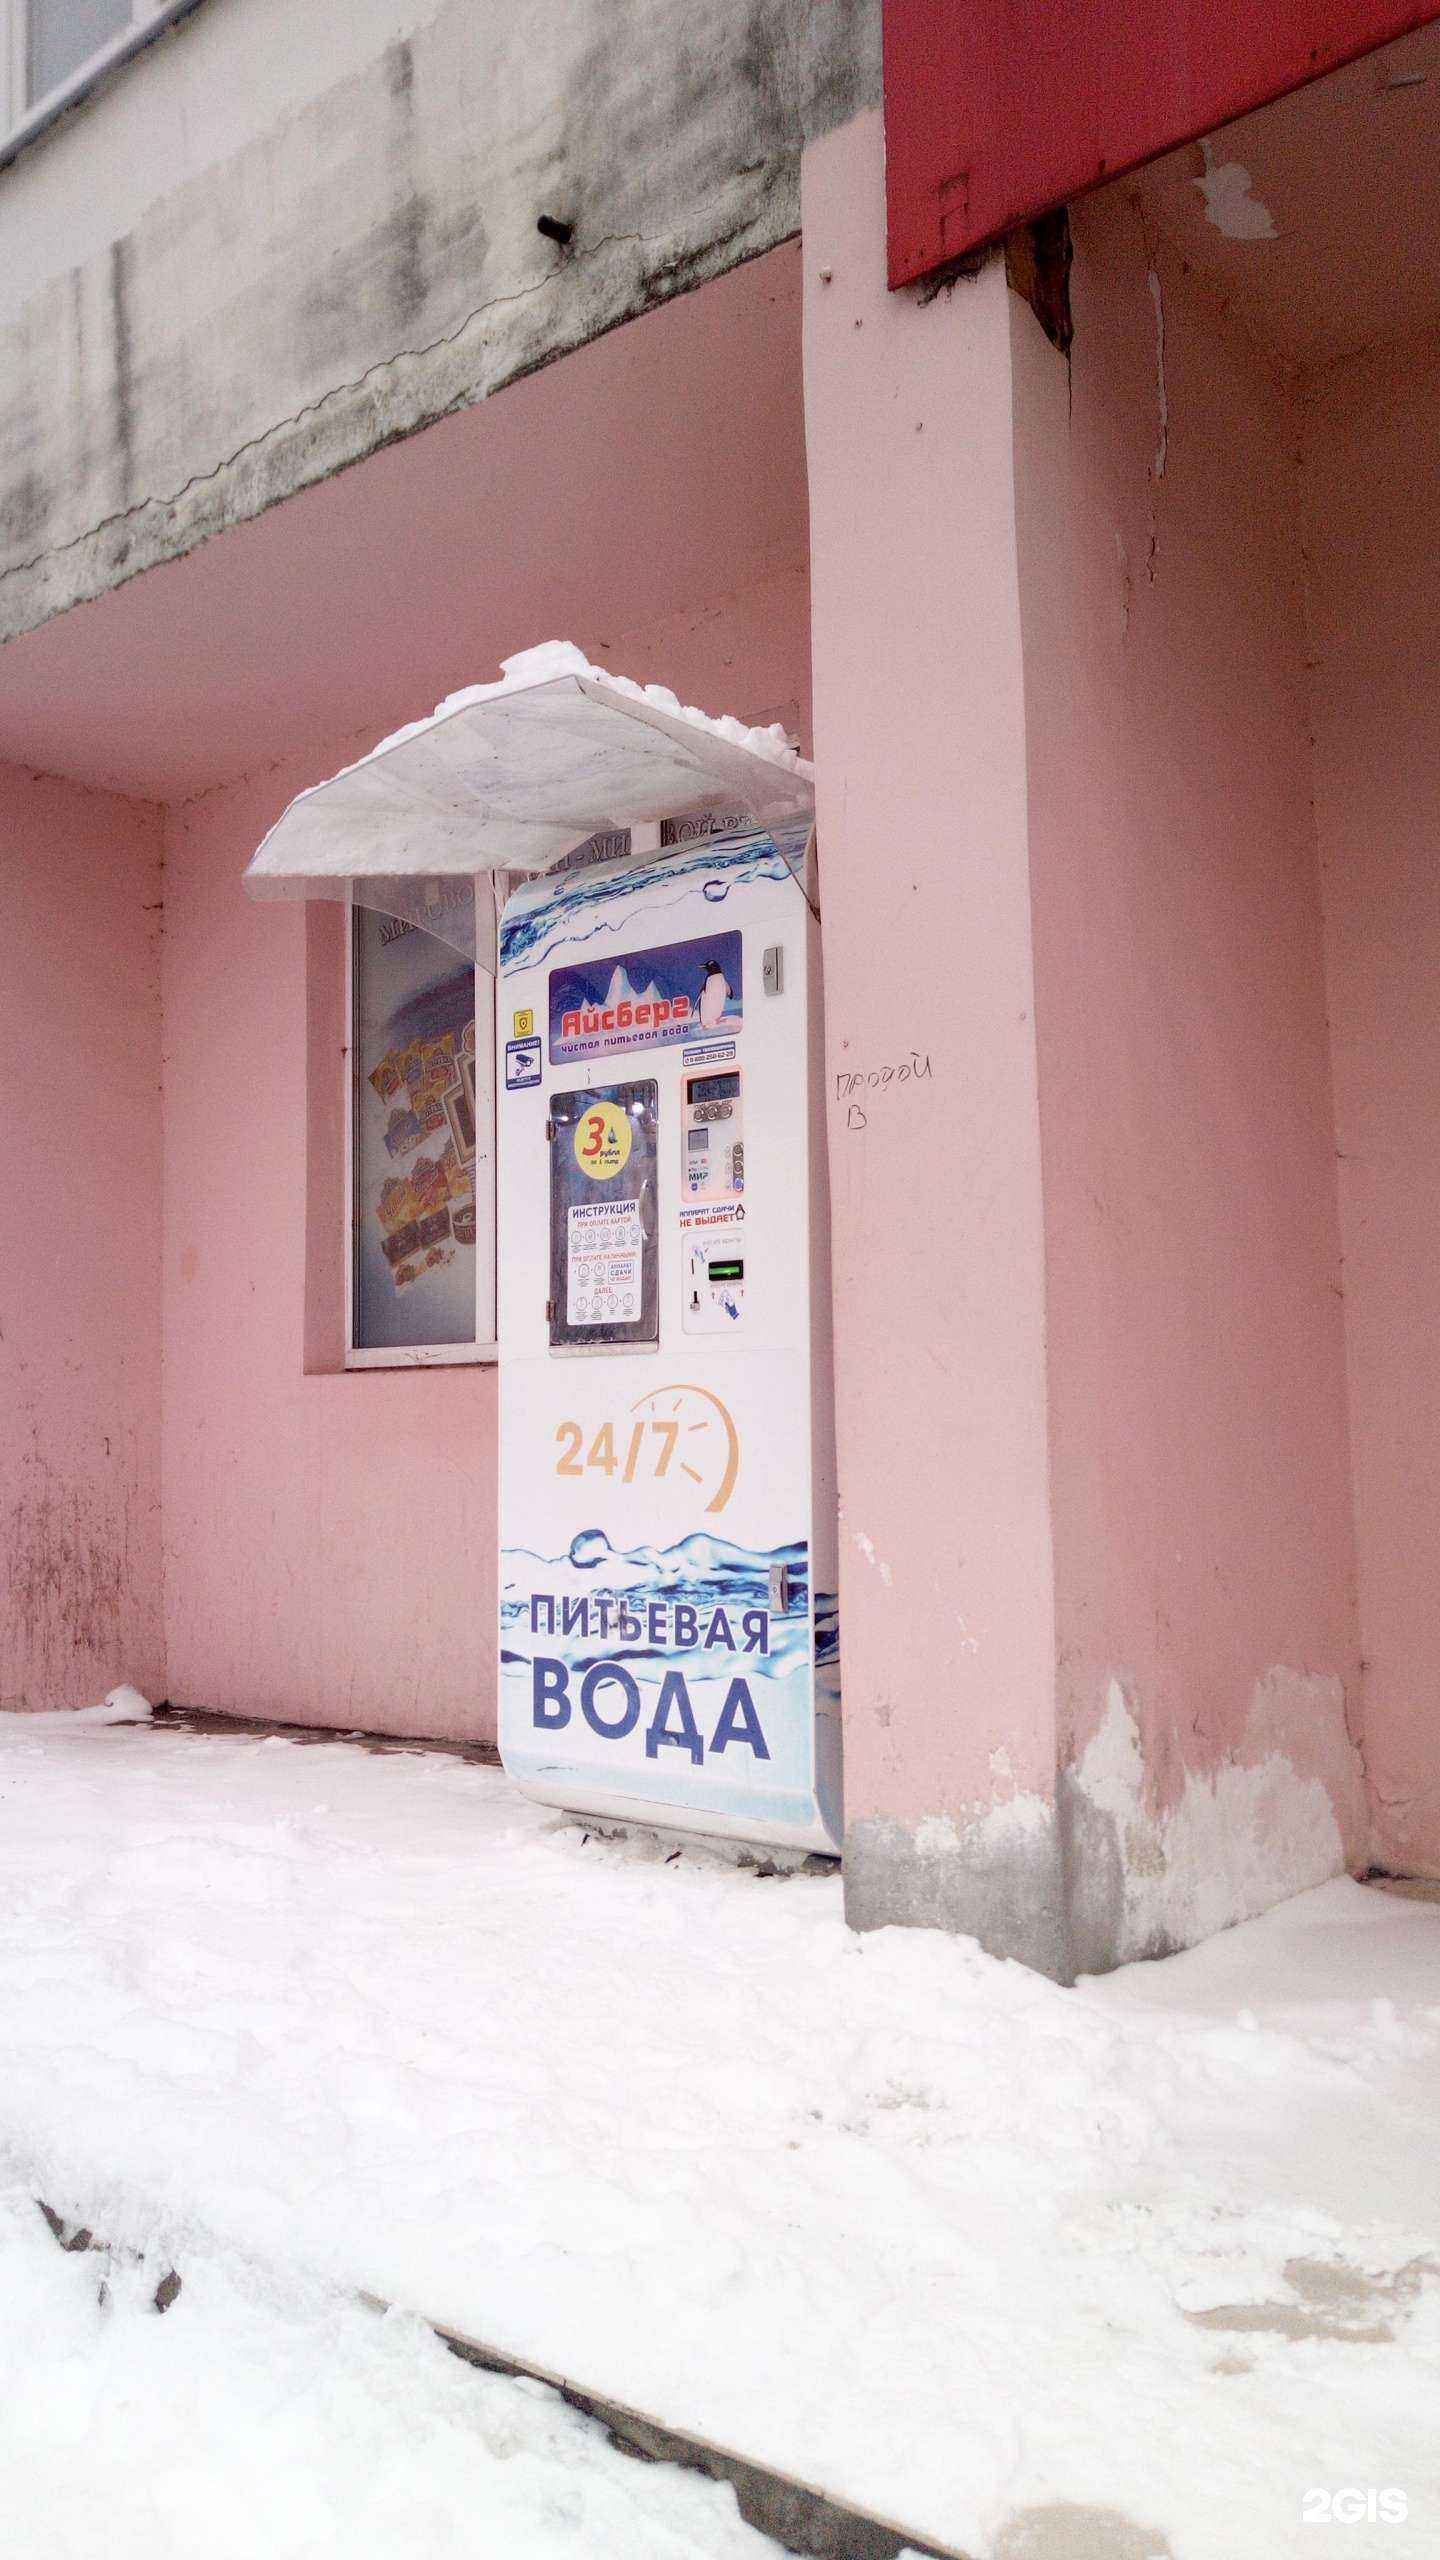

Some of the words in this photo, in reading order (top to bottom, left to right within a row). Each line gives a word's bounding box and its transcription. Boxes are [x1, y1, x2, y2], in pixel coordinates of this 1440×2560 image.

[562, 996, 690, 1038] Айсберг
[662, 1024, 689, 1037] вода
[582, 1116, 605, 1156] 3
[688, 1171, 709, 1181] МИР
[572, 1203, 636, 1218] ИНСТРУКЦИЯ
[680, 1218, 693, 1228] НЕ
[610, 1269, 632, 1277] СДАЧИ
[555, 1421, 679, 1483] 24/7
[530, 1594, 769, 1655] ПИТЬЕВАЯ
[532, 1656, 772, 1766] ВОДА
